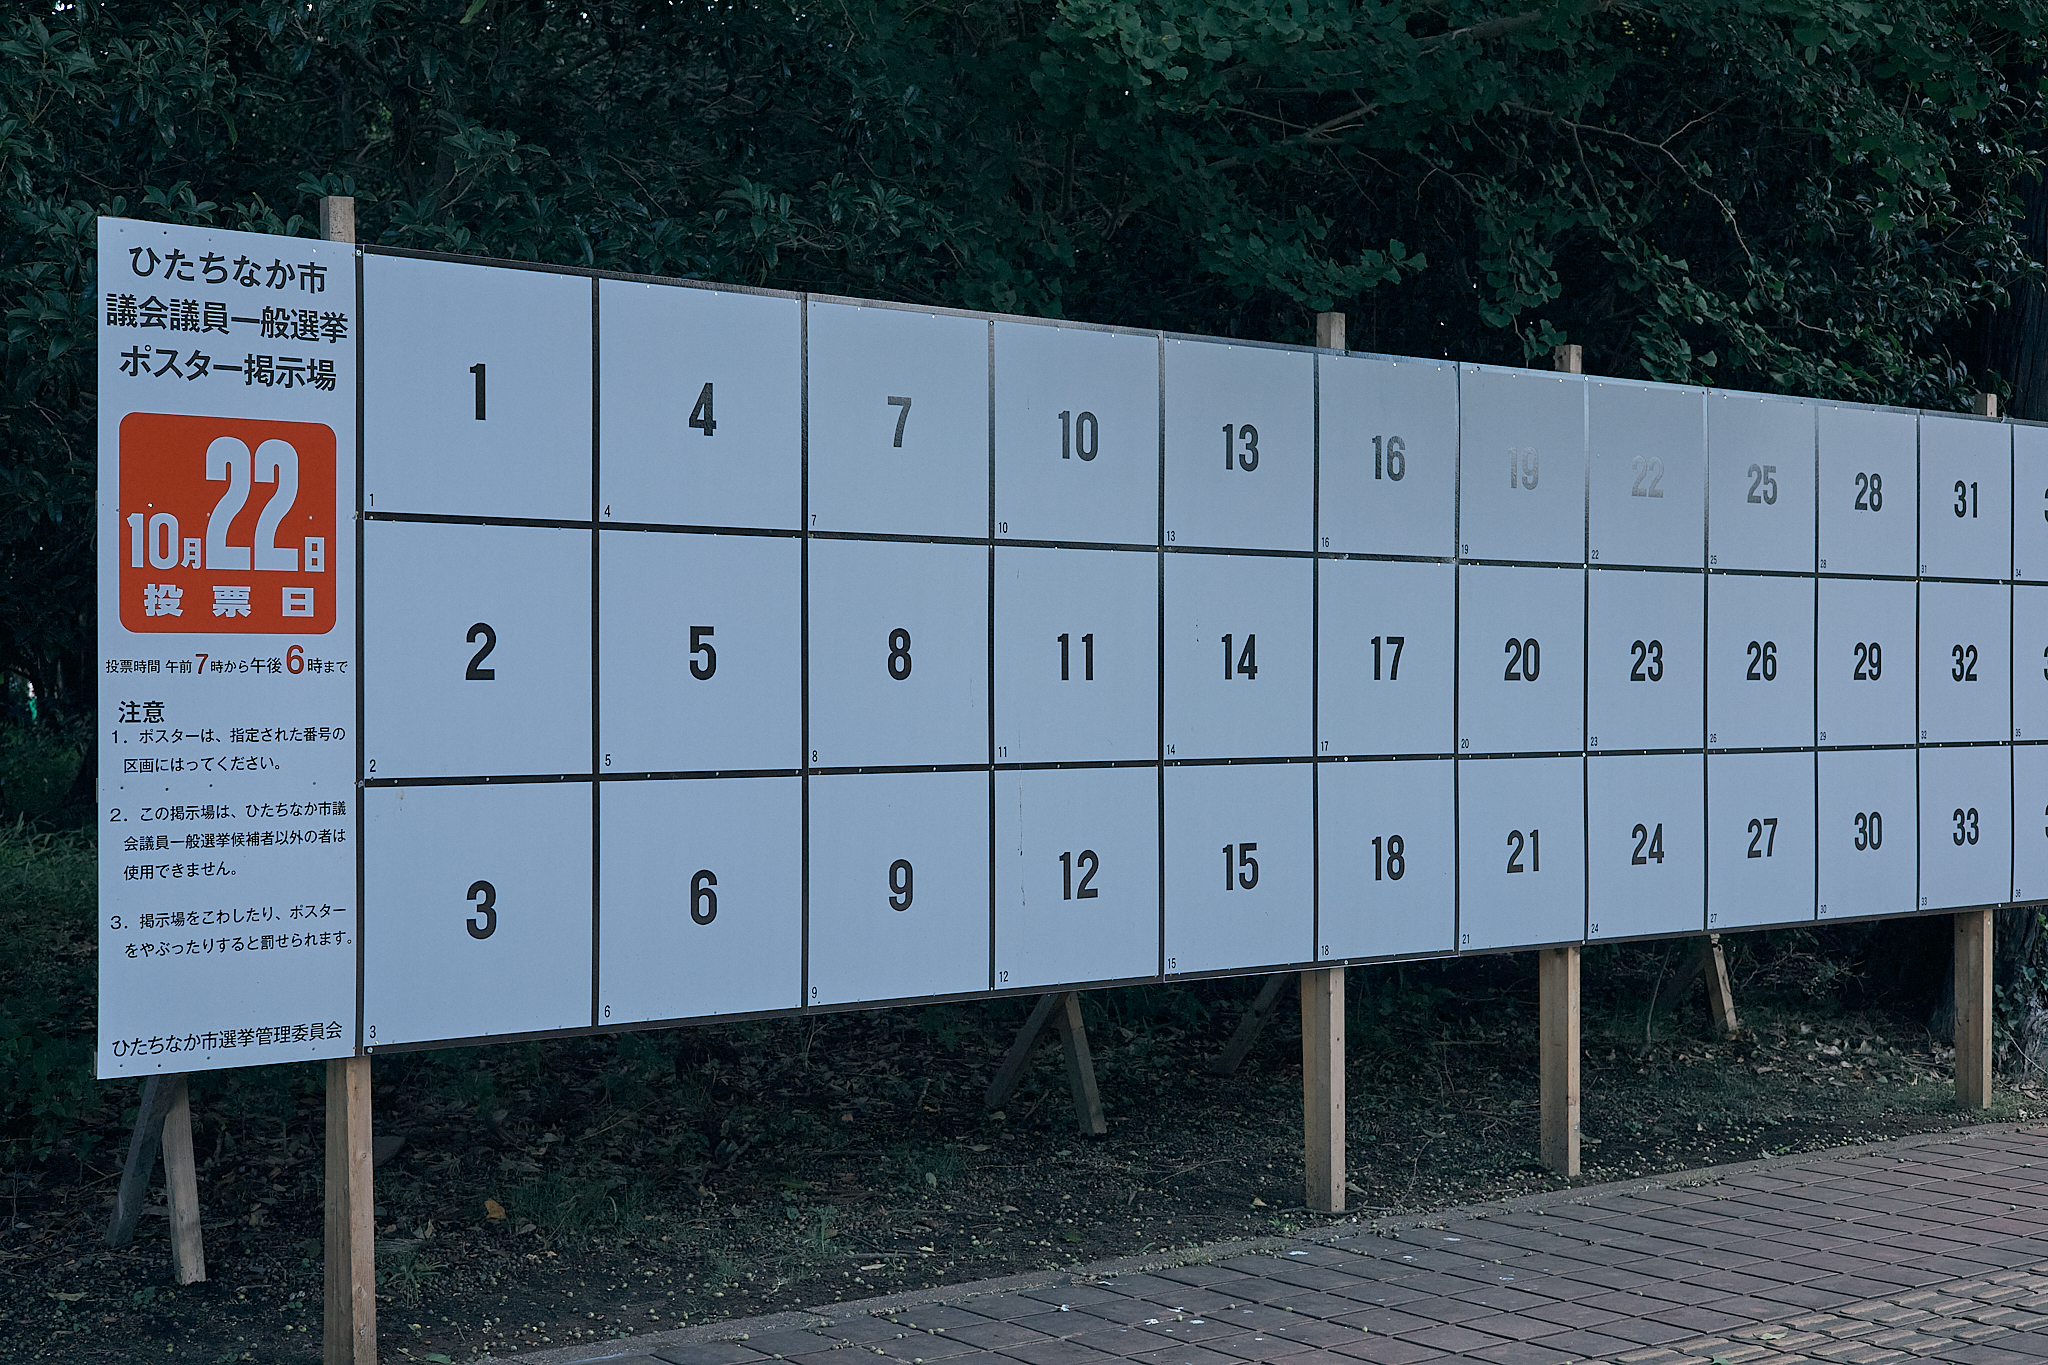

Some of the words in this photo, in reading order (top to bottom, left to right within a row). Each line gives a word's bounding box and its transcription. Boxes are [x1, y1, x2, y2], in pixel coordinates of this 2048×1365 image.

[129, 246, 327, 294] ひたちなか市
[106, 293, 349, 344] 議会議員一般選挙
[119, 345, 337, 391] ポスター掲示場
[469, 362, 487, 421] 1
[688, 381, 718, 437] 4
[887, 395, 912, 449] 7
[1057, 410, 1099, 462] 10
[1221, 423, 1260, 473] 13
[1371, 434, 1406, 482] 16
[1508, 446, 1539, 490] 19
[1631, 455, 1664, 498] 22
[1746, 463, 1778, 506] 25
[1854, 471, 1883, 513] 28
[369, 492, 374, 507] 1
[603, 504, 611, 518] 4
[1953, 479, 1978, 519] 31
[811, 513, 817, 527] 7
[998, 521, 1009, 534] 10
[1166, 530, 1176, 542] 13
[1321, 536, 1330, 548] 16
[1461, 543, 1469, 555] 19
[1591, 549, 1600, 560] 22
[1709, 554, 1718, 565] 25
[105, 659, 160, 674] 投票時間
[165, 645, 349, 674] 午前7時から午後6時まで
[464, 621, 497, 681] 2
[689, 625, 717, 681] 5
[887, 627, 913, 681] 8
[1056, 632, 1094, 681] 11
[1220, 633, 1259, 681] 14
[1370, 635, 1405, 681] 17
[1503, 637, 1541, 683] 20
[1629, 639, 1664, 683] 23
[1746, 640, 1778, 682] 26
[1853, 641, 1882, 682] 29
[1951, 643, 1979, 683] 32
[118, 700, 165, 723] 注意
[811, 749, 818, 763] 8
[998, 745, 1008, 758] 11
[1166, 743, 1176, 756] 14
[1320, 740, 1329, 752] 17
[1460, 738, 1470, 749] 20
[1590, 736, 1599, 747] 23
[1709, 733, 1718, 744] 26
[123, 756, 281, 773] 区画にはってください。
[369, 758, 377, 773] 2
[604, 753, 612, 767] 5
[123, 828, 346, 852] 会議員一般選挙候補者以外の者は
[1631, 822, 1665, 866] 24
[1746, 817, 1778, 859] 27
[1853, 811, 1883, 852] 30
[1952, 807, 1980, 847] 33
[123, 861, 237, 881] 使用できません。
[1222, 842, 1259, 891] 15
[1371, 834, 1406, 882] 18
[1506, 828, 1540, 874] 21
[888, 858, 914, 912] 9
[1058, 849, 1100, 901] 12
[465, 879, 498, 940] 3
[690, 868, 718, 926] 6
[1590, 922, 1599, 934] 24
[1710, 913, 1718, 924] 27
[125, 930, 352, 958] をやぶったりすると罰せられます。
[1321, 944, 1330, 956] 18
[1462, 933, 1470, 945] 21
[998, 970, 1009, 983] 12
[1167, 957, 1177, 970] 15
[604, 1004, 611, 1019] 6
[811, 986, 818, 999] 9
[112, 1020, 343, 1057] ひたちなか市選挙管理委員会
[369, 1024, 377, 1039] 3
